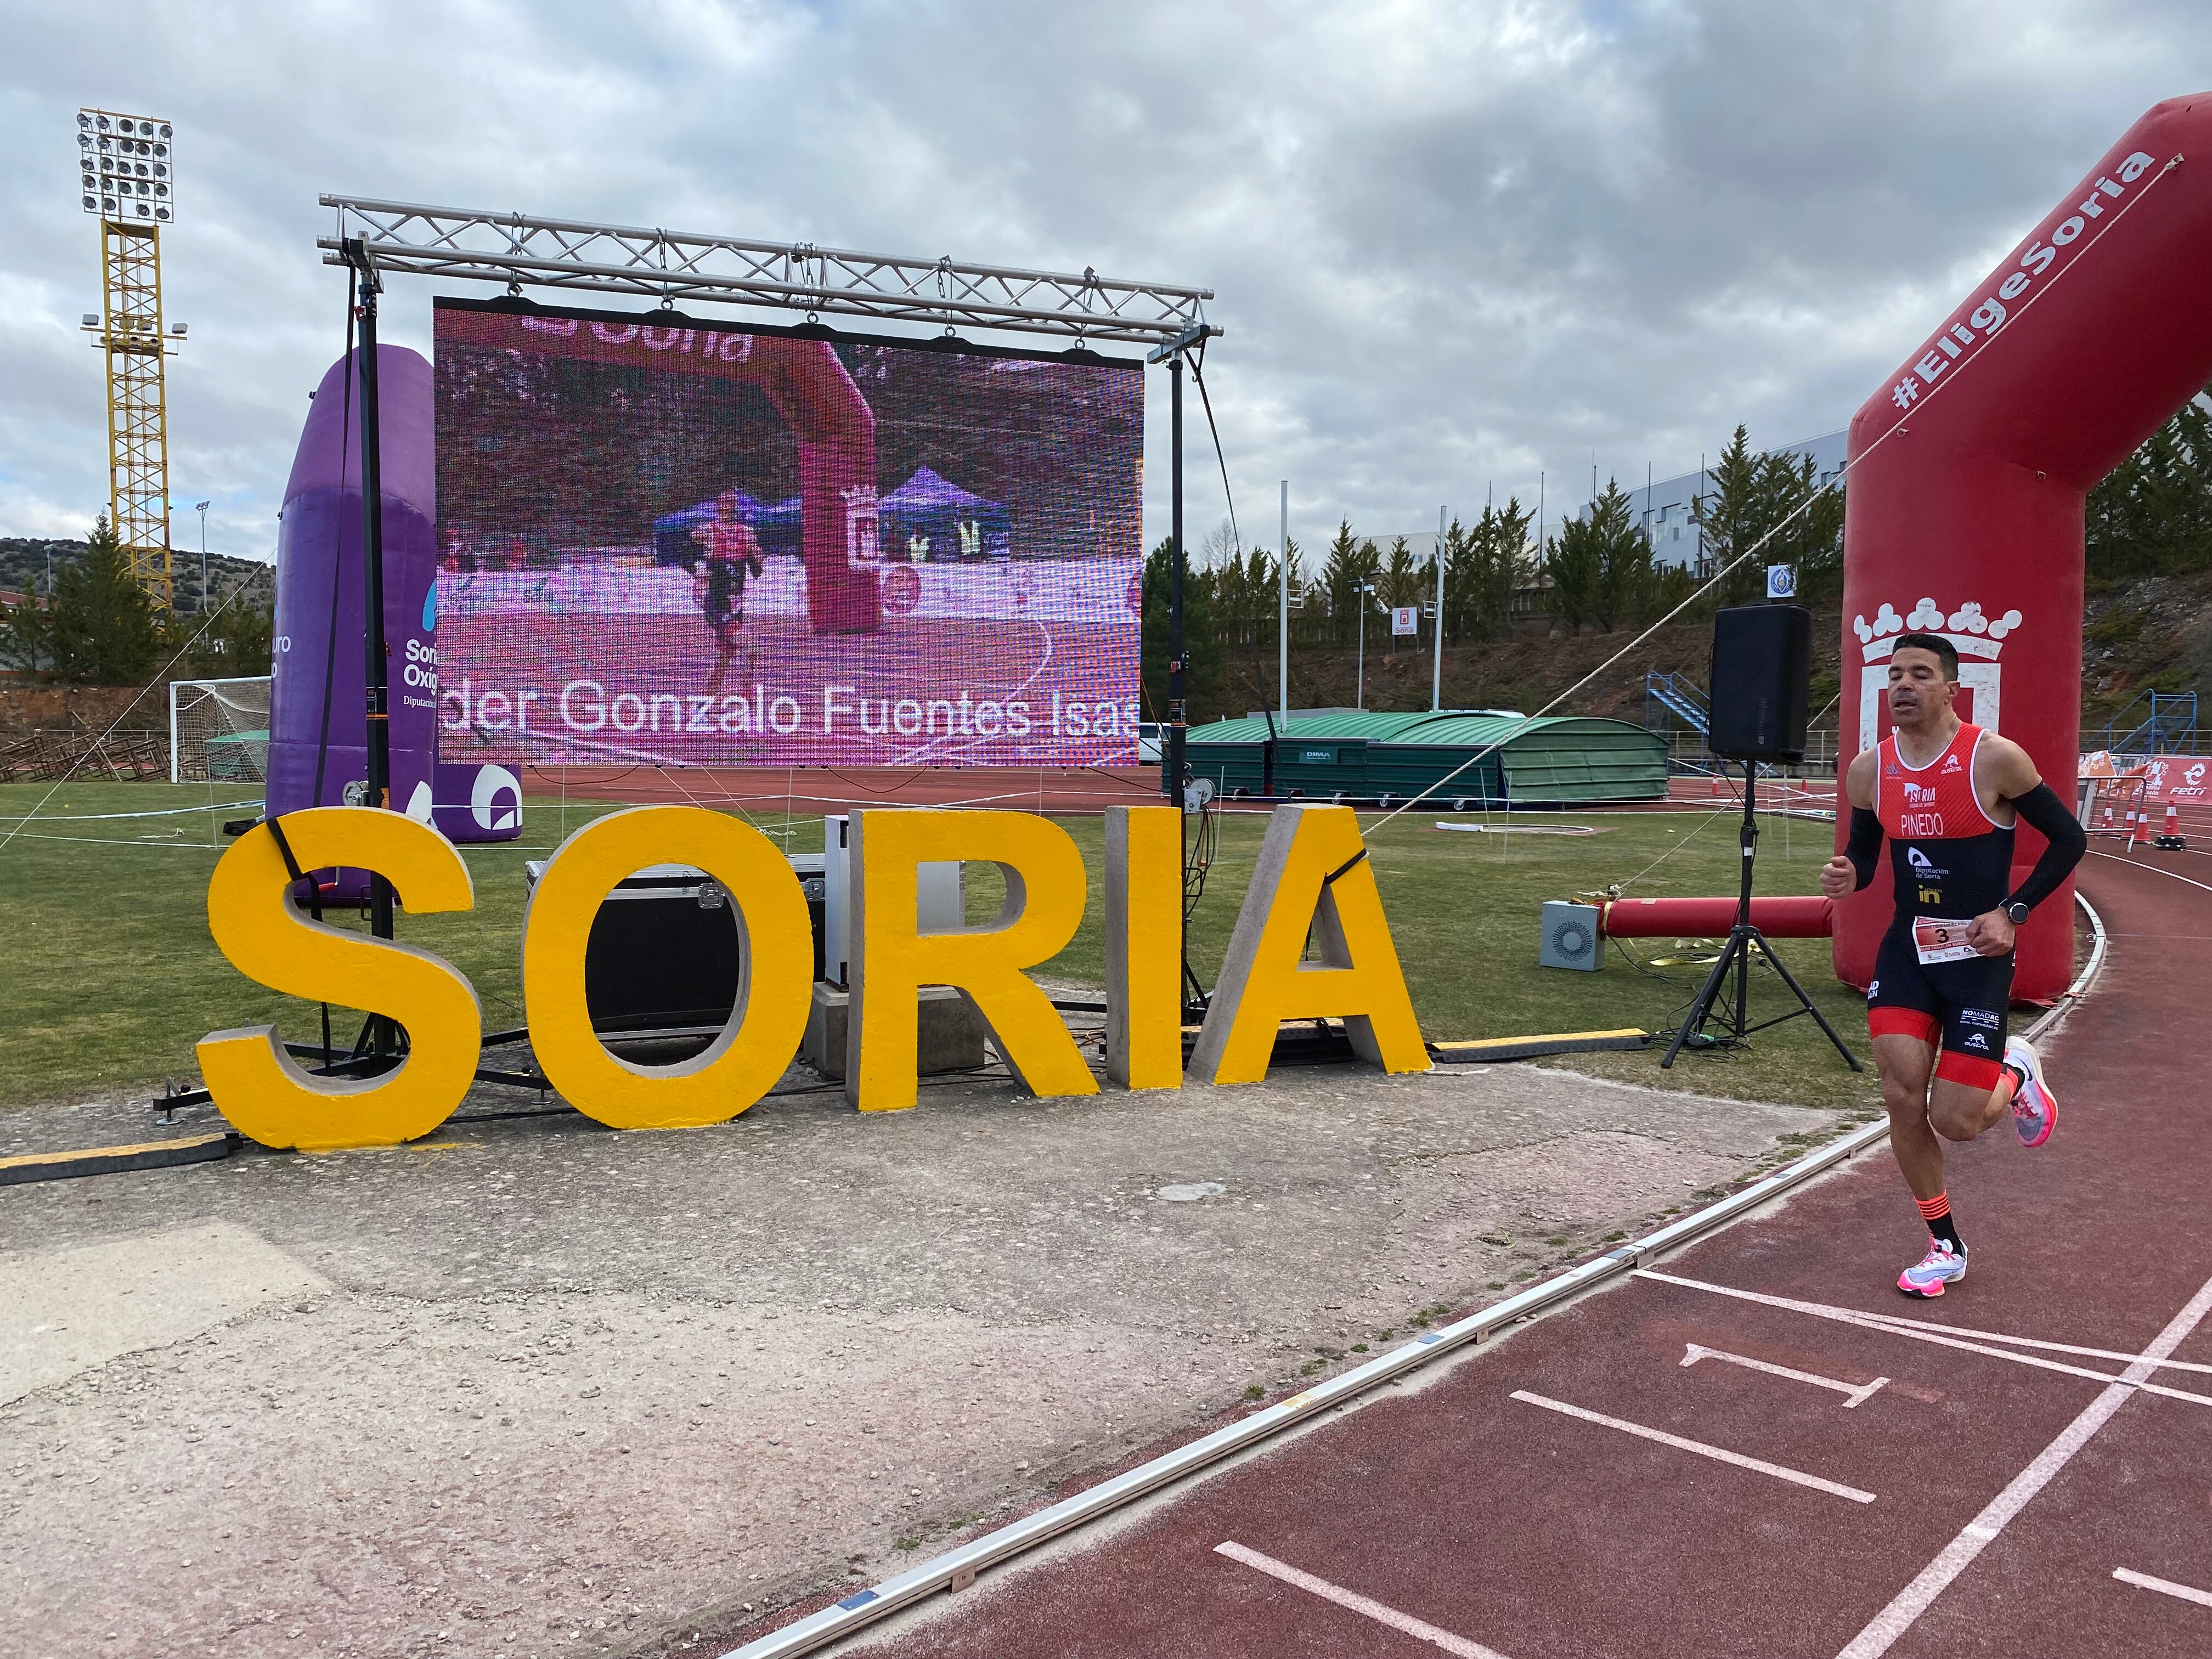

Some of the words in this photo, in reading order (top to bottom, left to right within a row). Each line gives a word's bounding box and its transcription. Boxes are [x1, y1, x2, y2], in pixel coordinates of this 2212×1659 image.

[1892, 151, 2156, 410] #EligeSoria
[404, 664, 437, 696] Oxíg
[560, 679, 802, 734] Gonzalo
[824, 686, 1031, 736] Fuentes
[1901, 812, 1943, 836] PINEDO
[1918, 884, 1940, 904] in
[1935, 928, 1950, 943] 3
[195, 804, 1434, 1150] SORIA
[1962, 1009, 1999, 1021] NOMADAC
